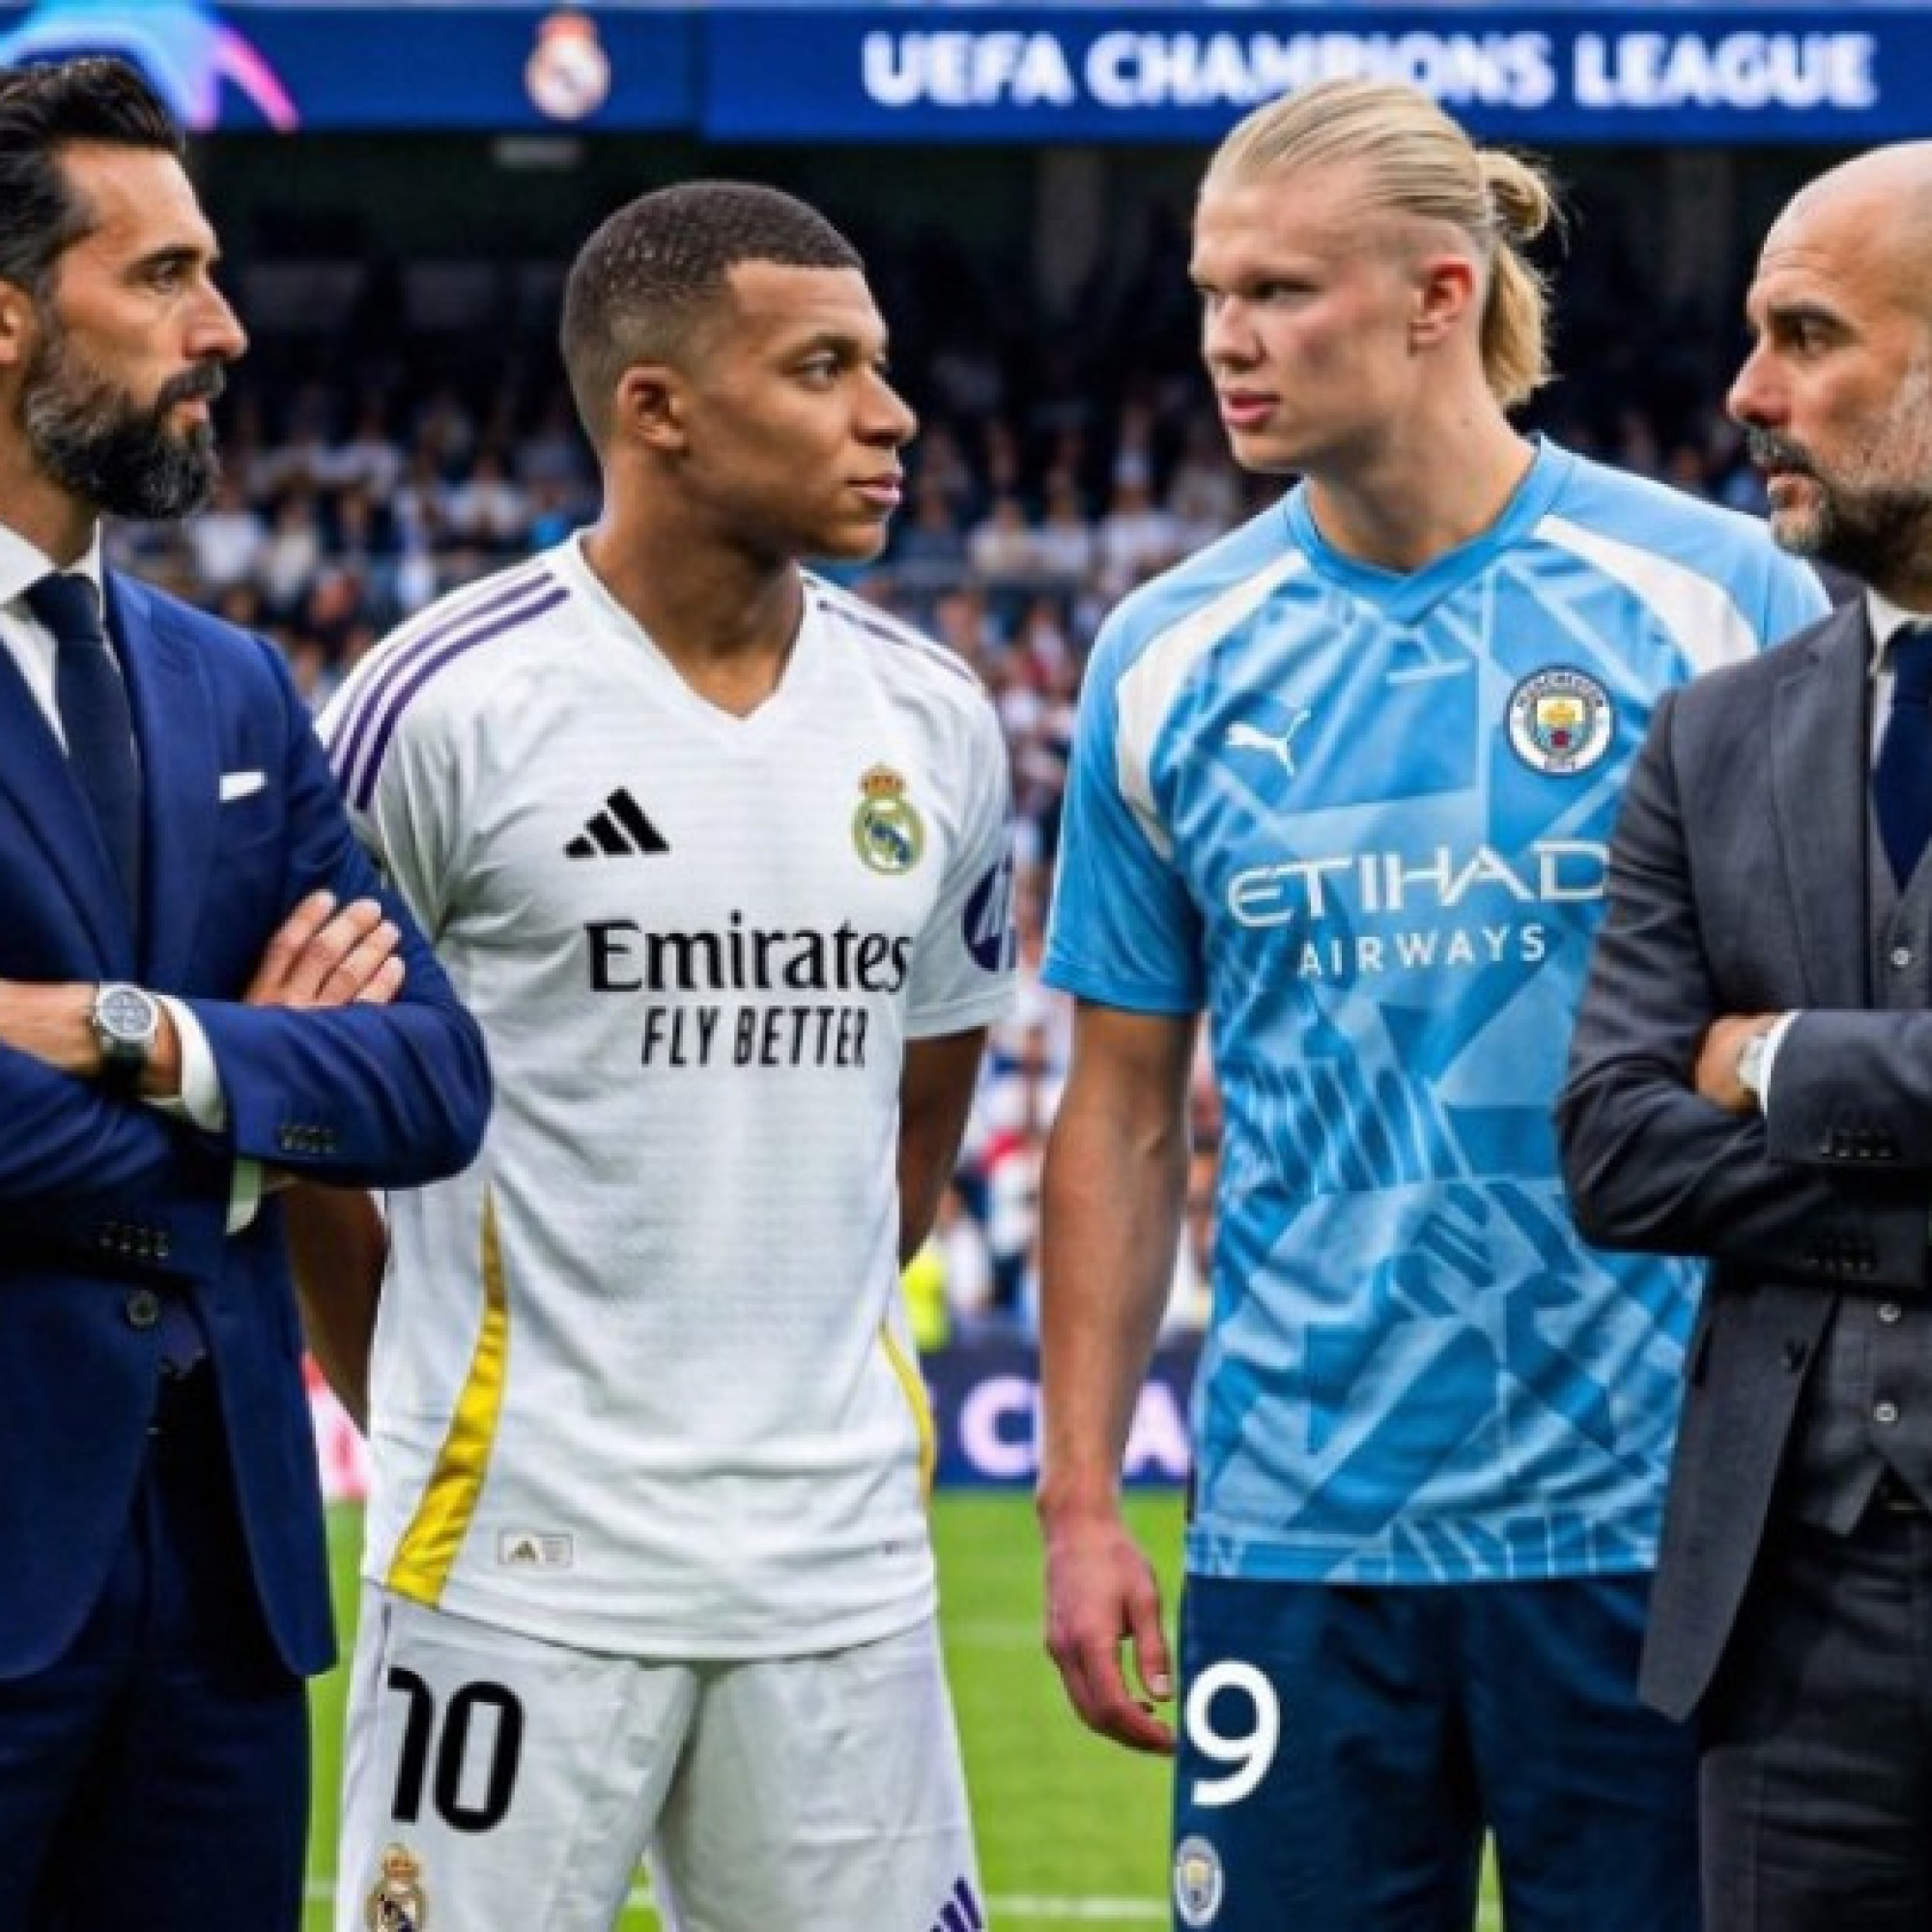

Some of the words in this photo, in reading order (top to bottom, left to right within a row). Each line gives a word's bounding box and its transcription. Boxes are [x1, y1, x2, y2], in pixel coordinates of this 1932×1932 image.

[863, 32, 1078, 107] UEFA
[1085, 31, 1554, 107] CHAMPIONS
[1574, 32, 1878, 108] LEAGUE
[1228, 838, 1610, 926] ETIHAD
[583, 909, 912, 994] Emirates
[1298, 924, 1547, 978] AIRWAYS
[641, 1006, 720, 1067] FLY
[734, 1006, 868, 1069] BETTER
[387, 1666, 525, 1833] 10
[1186, 1658, 1279, 1806] 9
